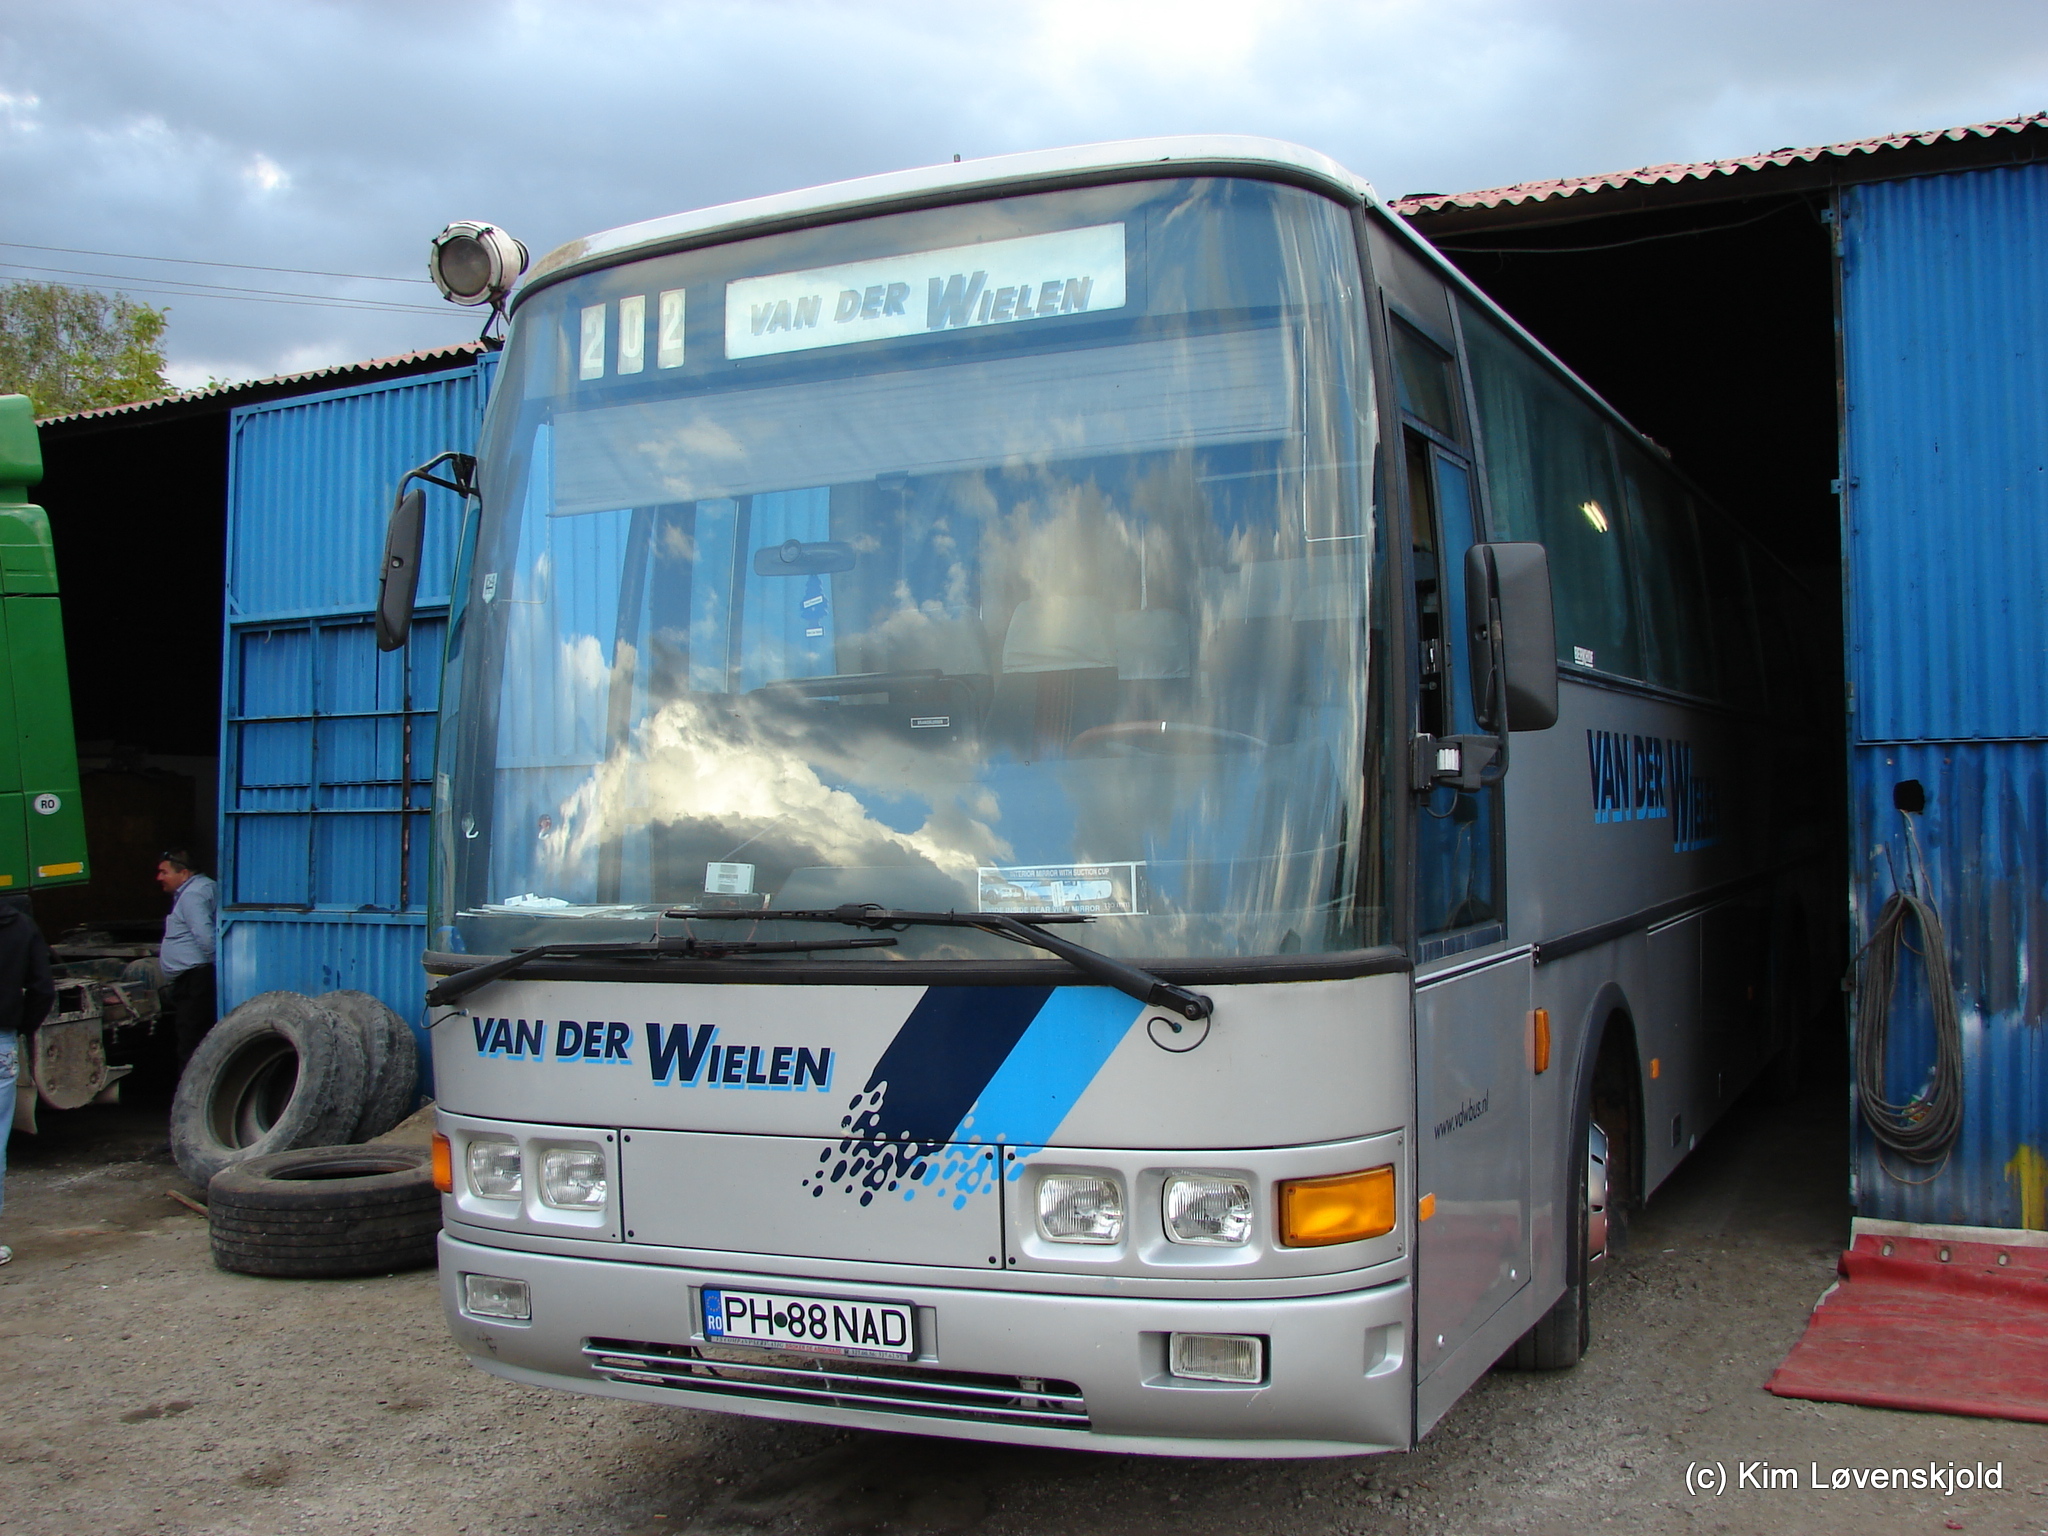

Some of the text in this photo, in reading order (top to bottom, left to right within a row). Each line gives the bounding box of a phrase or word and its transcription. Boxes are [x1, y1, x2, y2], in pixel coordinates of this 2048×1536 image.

[583, 293, 682, 369] 202
[750, 295, 823, 337] VAN
[833, 282, 911, 324] DER
[1587, 729, 1632, 824] VAN
[1634, 735, 1668, 820] DER
[41, 799, 55, 809] RO
[1010, 867, 1110, 878] INTERIOR MIRROR WITH SUCTION CUP
[1071, 905, 1101, 913] MIRROR
[472, 1016, 836, 1093] VAN DER WIELEN
[1433, 1088, 1489, 1140] www.vdwbus.nl
[707, 1315, 723, 1330] RO
